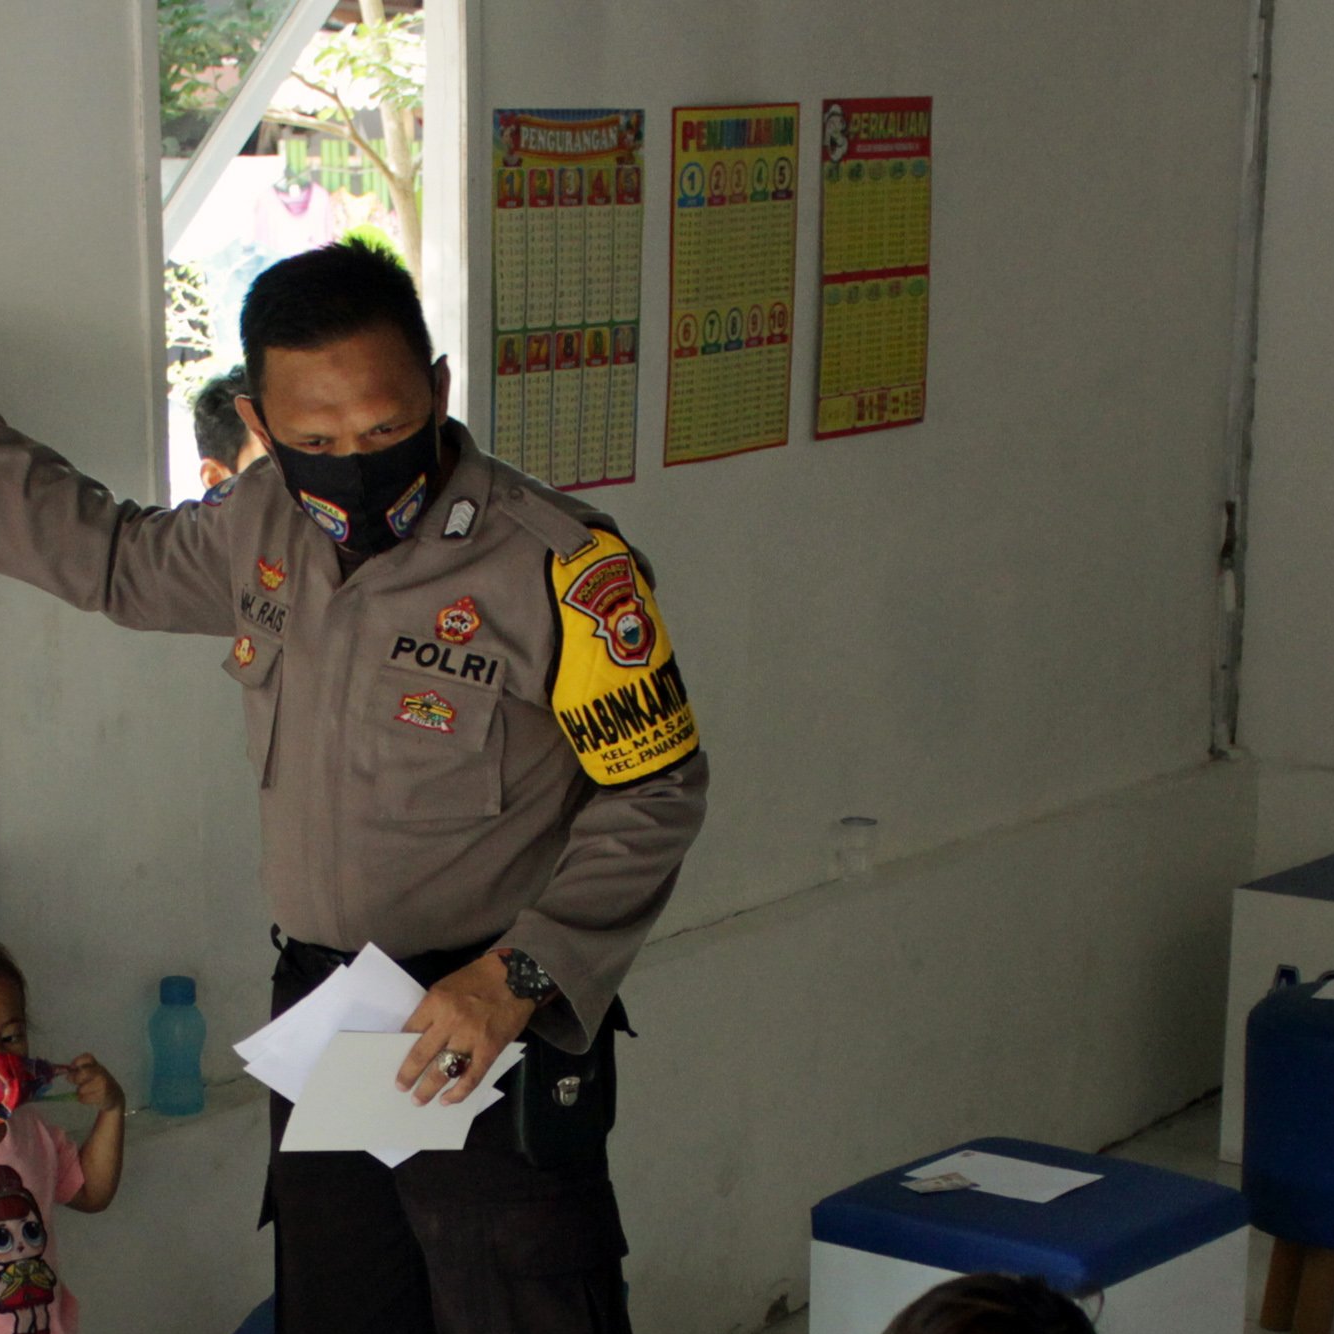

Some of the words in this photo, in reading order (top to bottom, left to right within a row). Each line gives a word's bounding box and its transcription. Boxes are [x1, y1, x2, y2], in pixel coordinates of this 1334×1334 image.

[519, 125, 618, 154] PENGURANGAN
[850, 112, 929, 139] PERKALIAN
[257, 602, 285, 632] RAIS
[391, 635, 498, 686] POLRI
[602, 747, 632, 761] KEL.
[606, 759, 639, 775] KEC.
